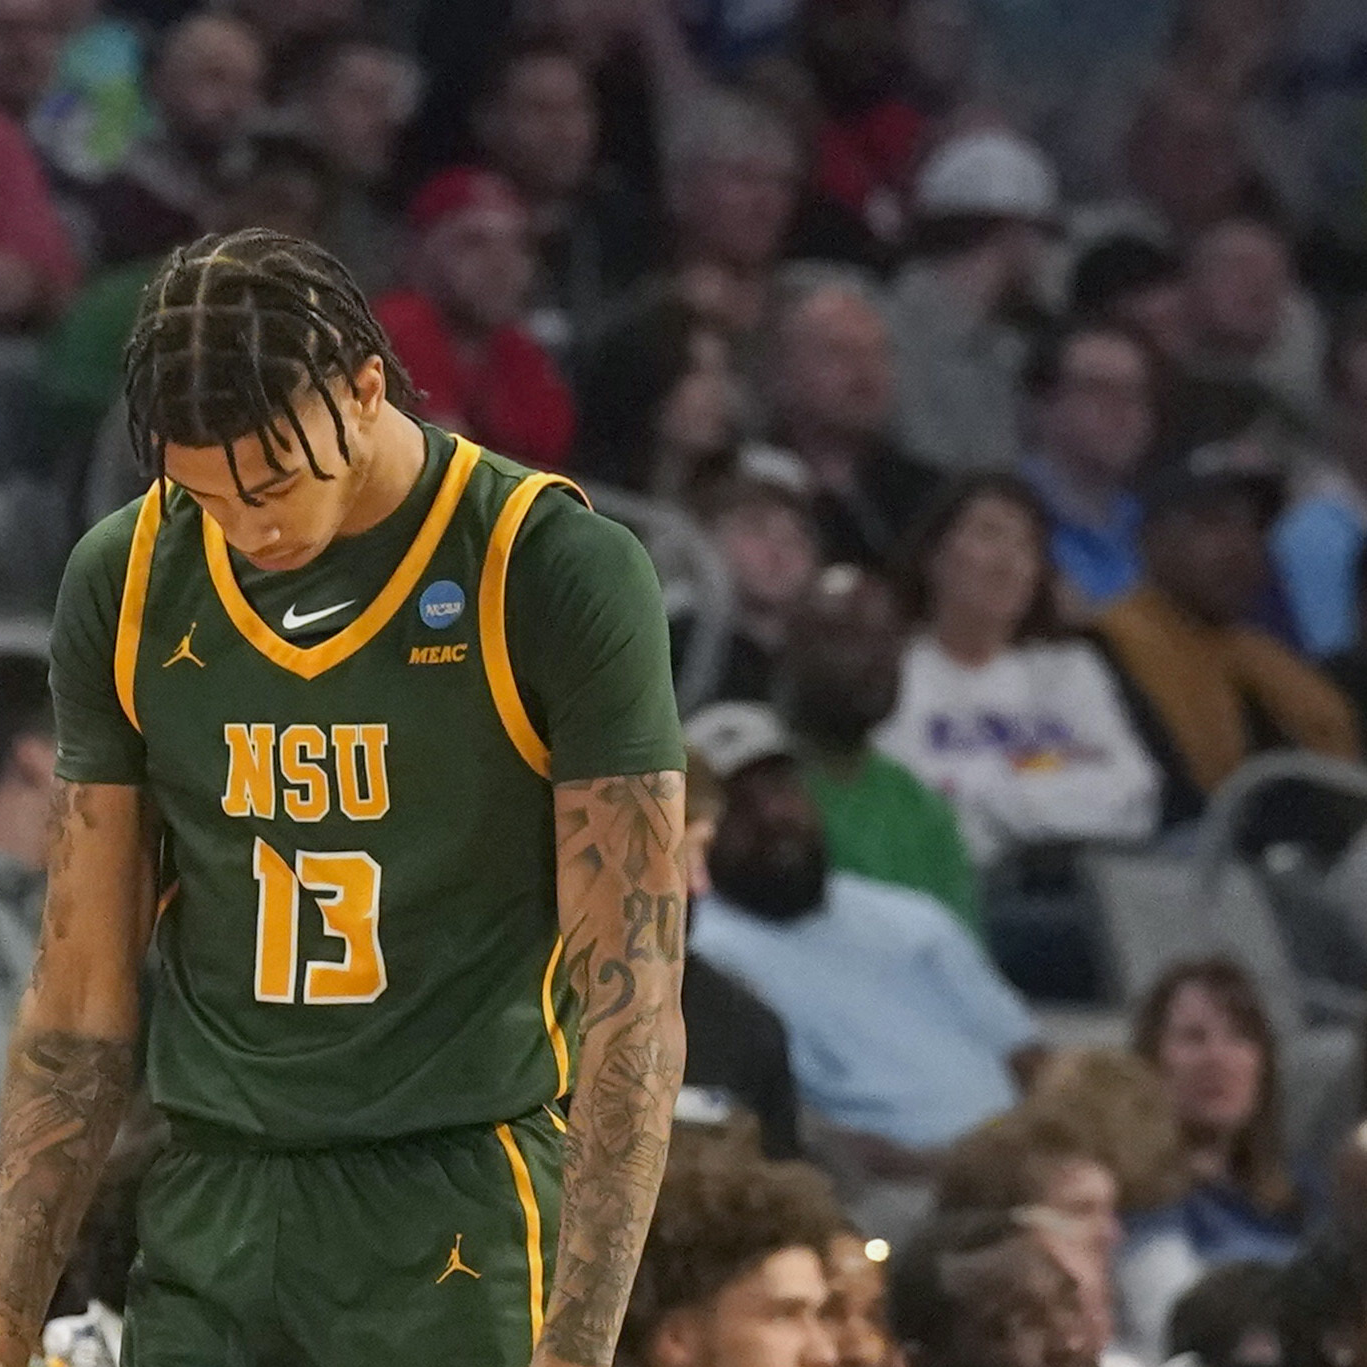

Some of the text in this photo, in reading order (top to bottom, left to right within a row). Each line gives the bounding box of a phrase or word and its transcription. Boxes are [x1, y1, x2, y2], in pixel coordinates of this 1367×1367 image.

[408, 643, 468, 665] MEAC
[221, 724, 390, 822] NSU
[253, 836, 388, 1004] 13
